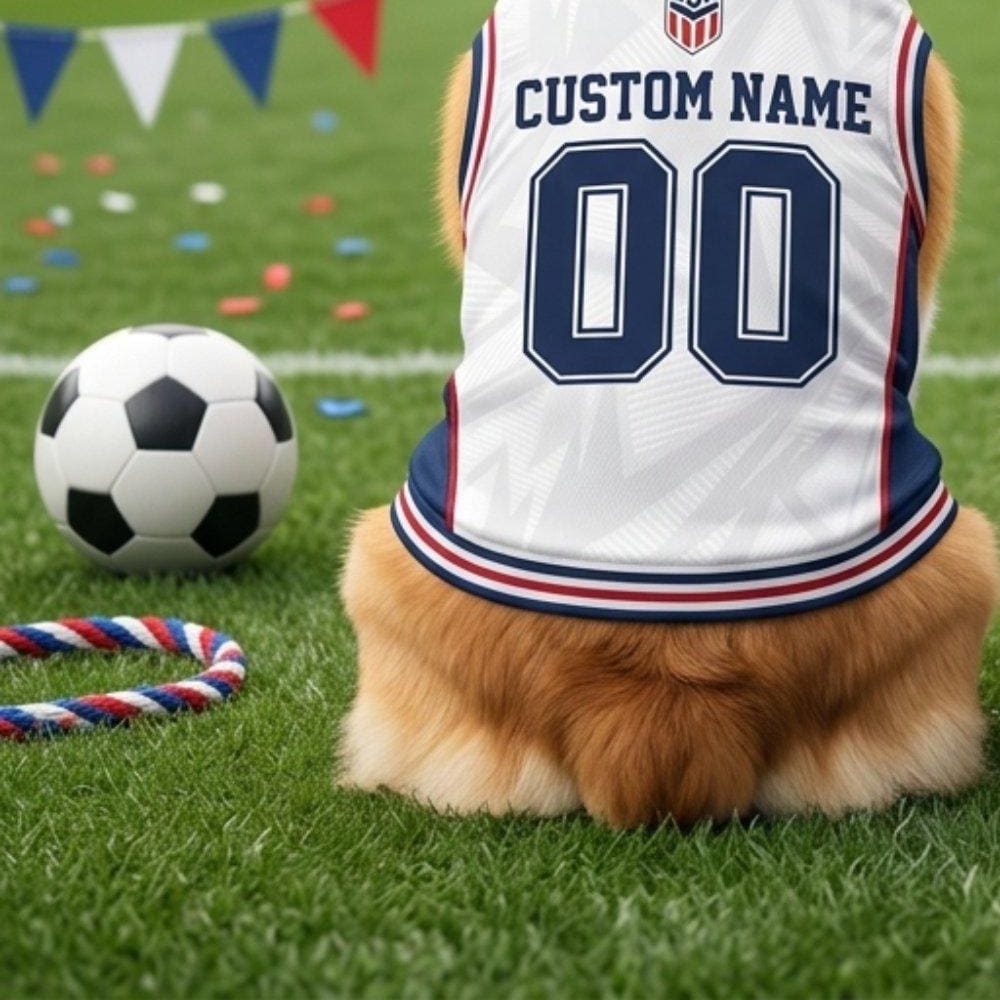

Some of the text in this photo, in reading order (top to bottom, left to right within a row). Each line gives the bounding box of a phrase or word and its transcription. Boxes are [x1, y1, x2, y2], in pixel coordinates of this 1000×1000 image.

[515, 70, 872, 135] CUSTOM NAME
[523, 138, 840, 388] 00
